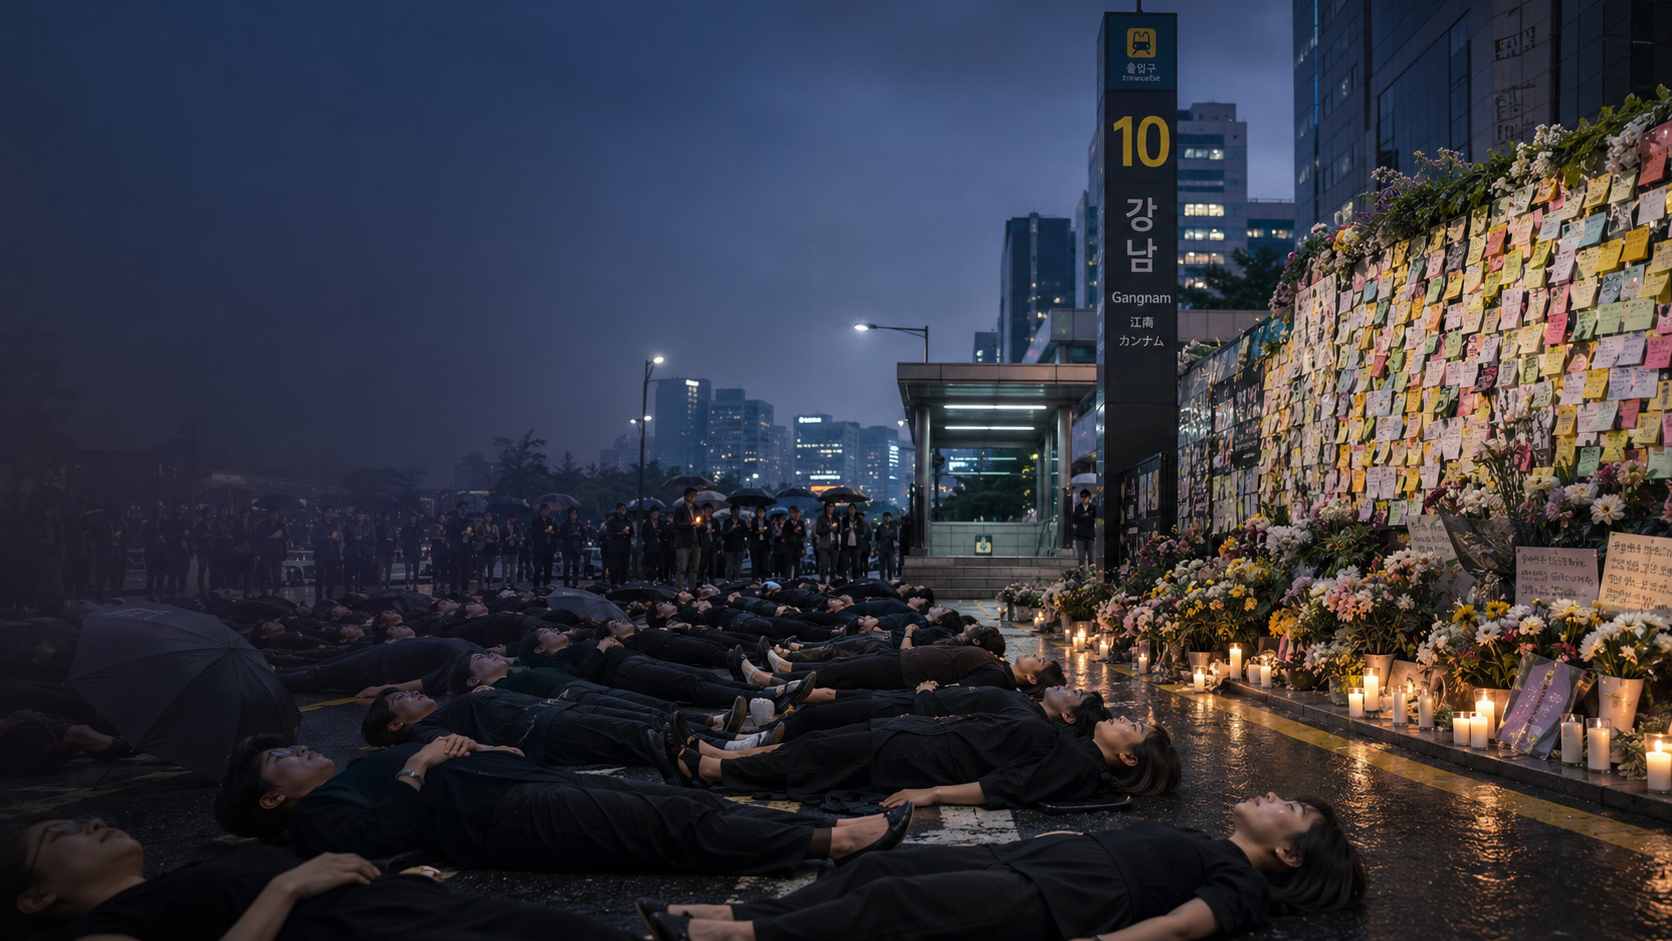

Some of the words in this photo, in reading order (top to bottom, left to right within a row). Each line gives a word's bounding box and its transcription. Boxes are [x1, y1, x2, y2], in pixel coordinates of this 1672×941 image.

[1112, 115, 1170, 168] 10
[1112, 292, 1172, 307] Gangnam
[1119, 335, 1165, 347] カンナム
